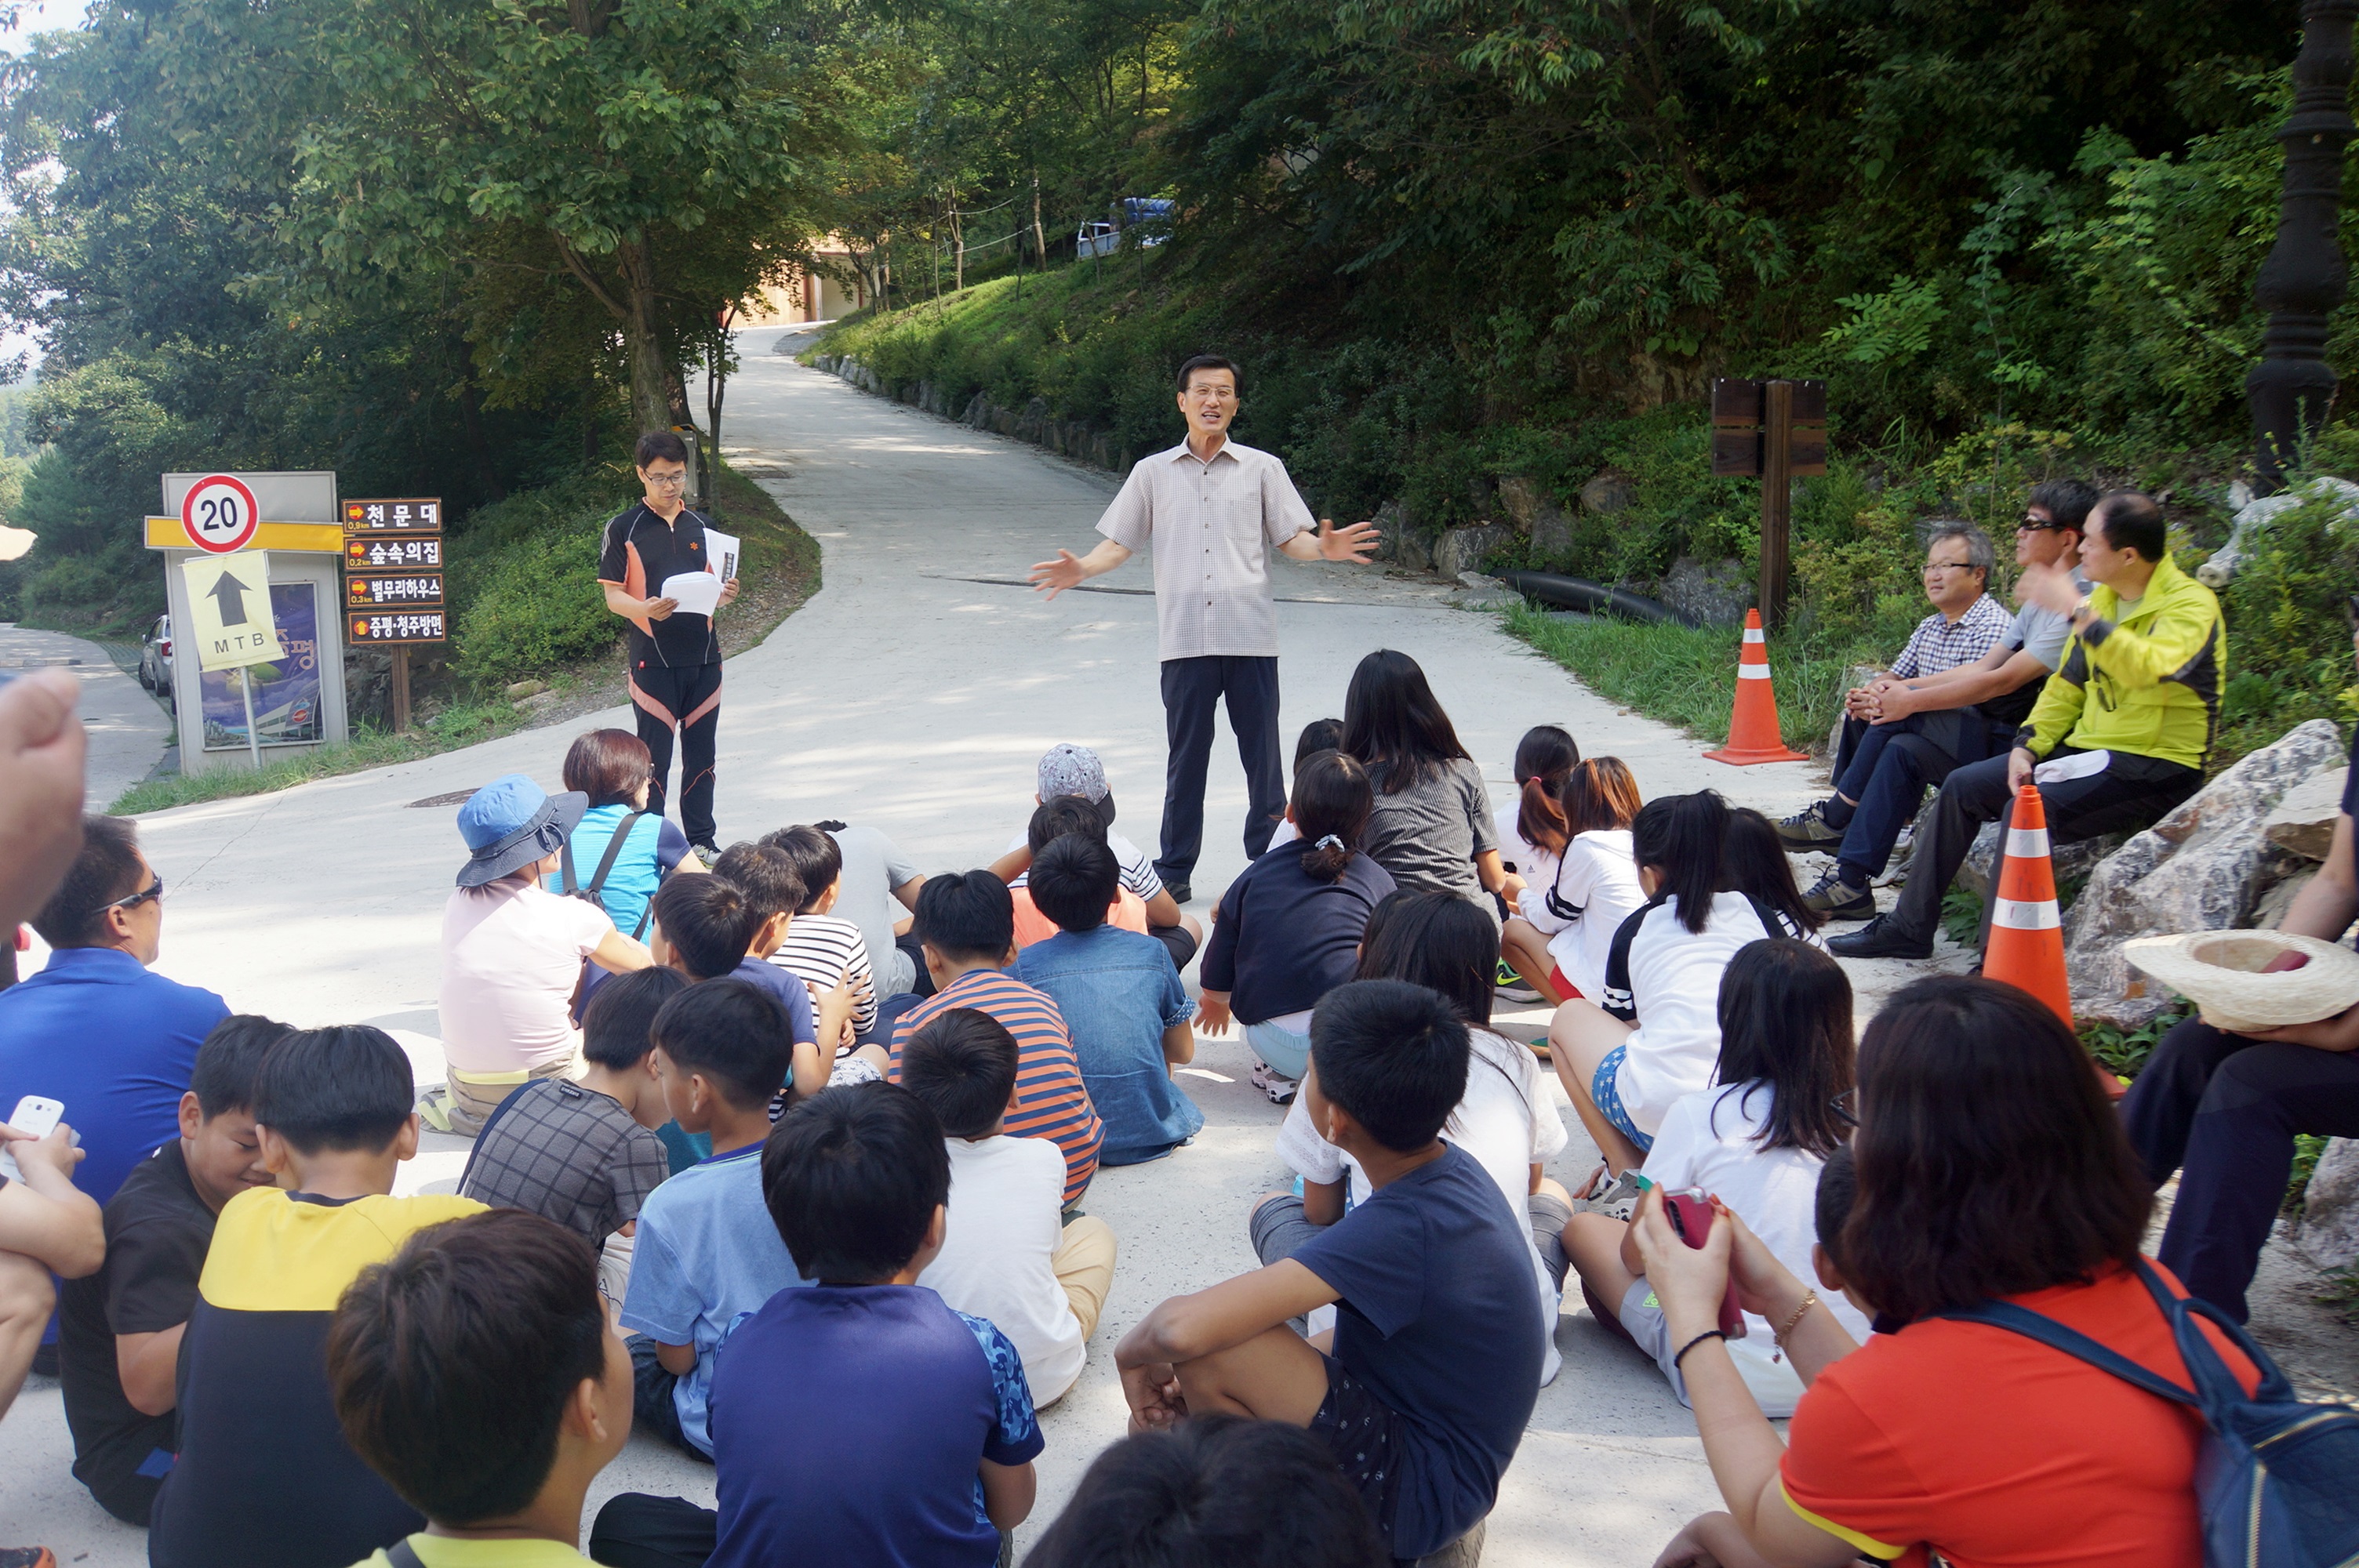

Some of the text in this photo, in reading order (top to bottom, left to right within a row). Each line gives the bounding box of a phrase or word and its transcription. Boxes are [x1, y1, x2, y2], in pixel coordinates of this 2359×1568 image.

[201, 496, 238, 532] 20
[369, 541, 438, 564] 숲속의집
[372, 579, 441, 602] 별무리하우스
